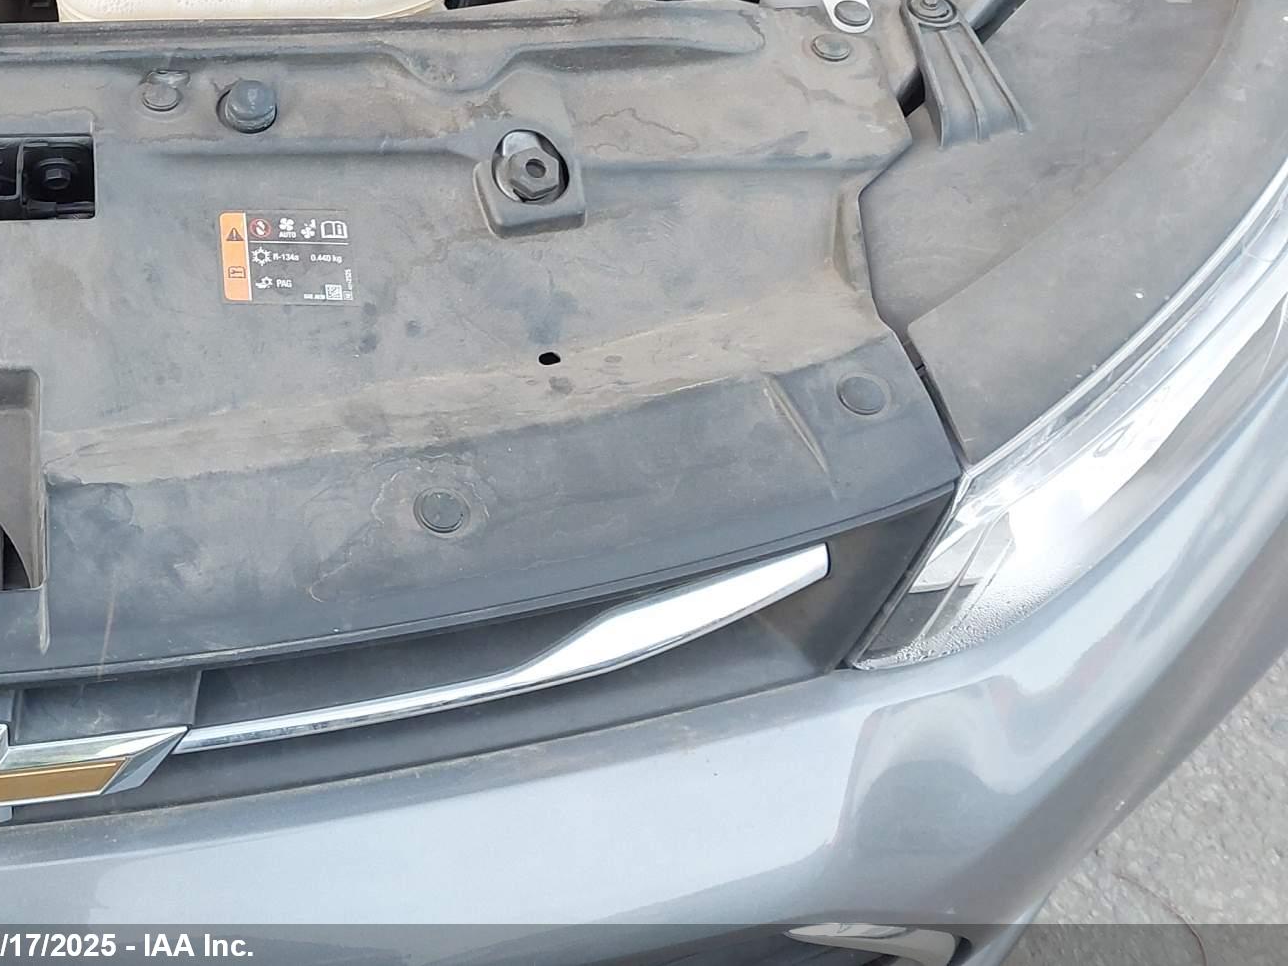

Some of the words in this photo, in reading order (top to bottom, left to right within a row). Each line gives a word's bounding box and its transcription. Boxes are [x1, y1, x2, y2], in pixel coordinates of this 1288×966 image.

[279, 230, 297, 239] AUTO
[310, 253, 332, 262] 0.440
[332, 254, 343, 264] kg
[276, 278, 293, 288] PAG
